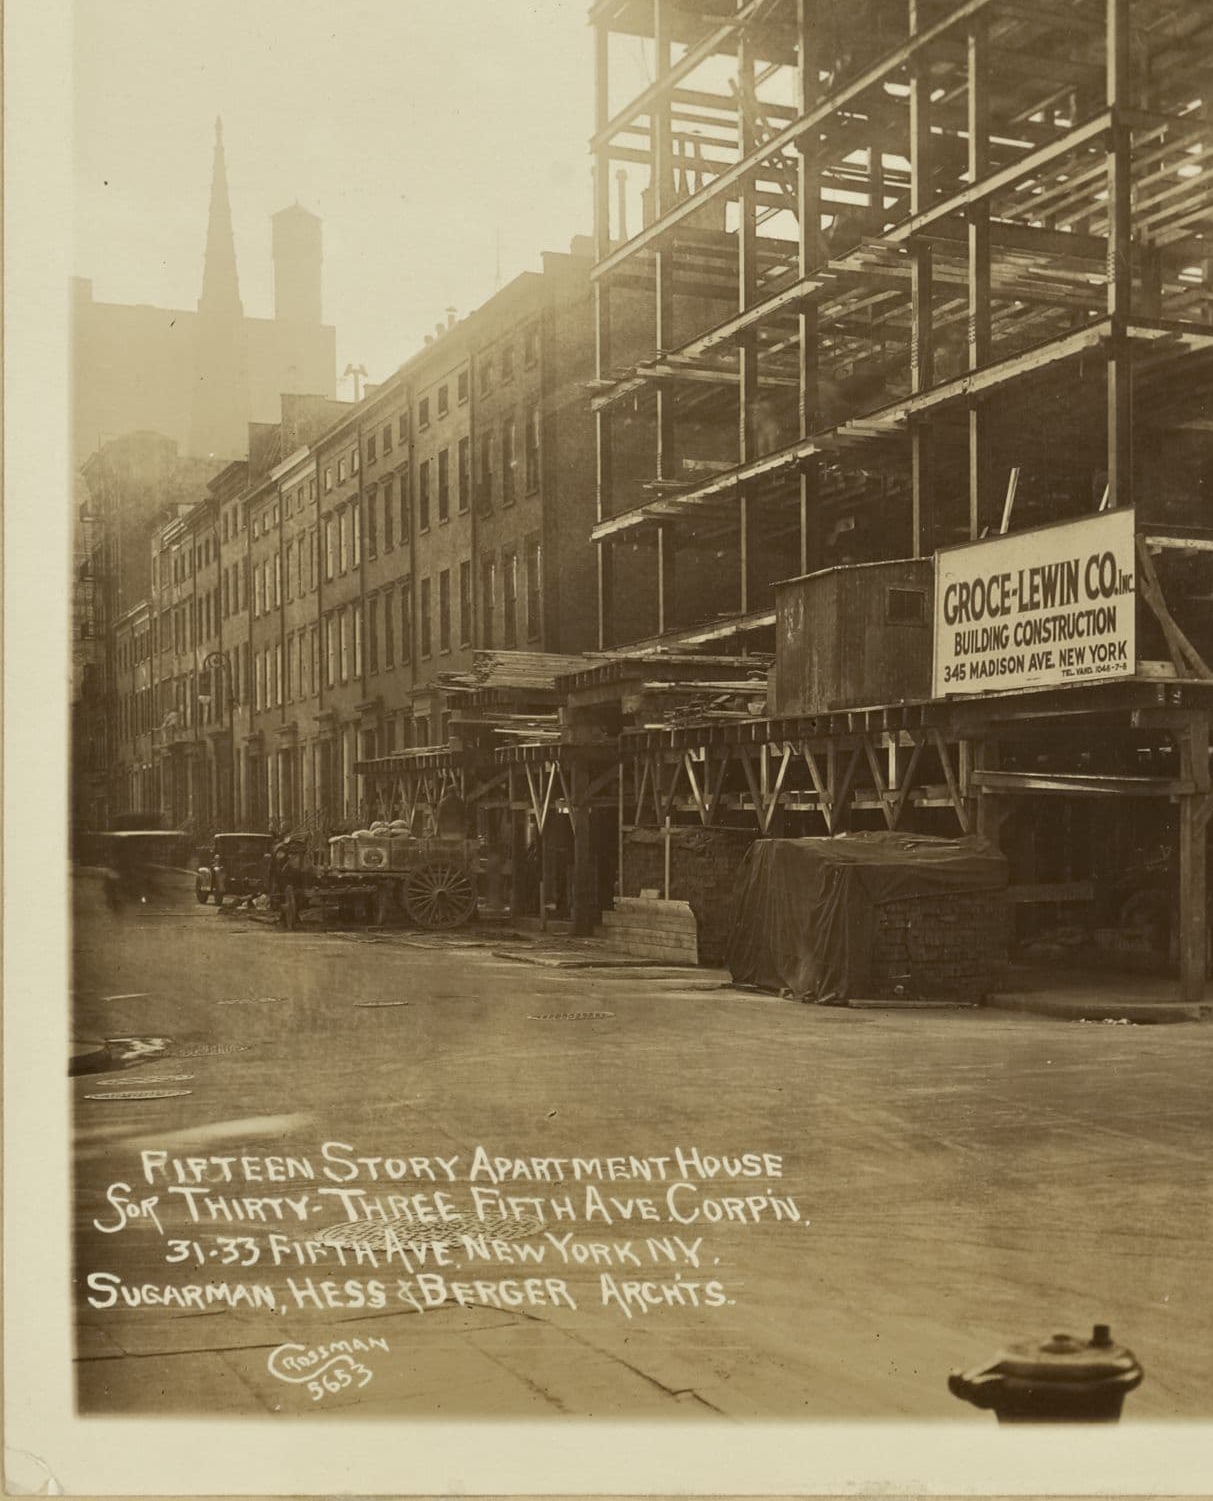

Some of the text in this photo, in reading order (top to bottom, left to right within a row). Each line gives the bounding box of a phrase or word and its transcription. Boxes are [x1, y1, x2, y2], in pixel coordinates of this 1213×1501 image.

[944, 558, 1080, 625] GROCE-LEWIN
[1085, 551, 1118, 600] CO.
[954, 606, 1117, 656] BUILDING CONSTRUCTION
[944, 640, 1127, 682] 345 MADISON AVE. NEW YORK
